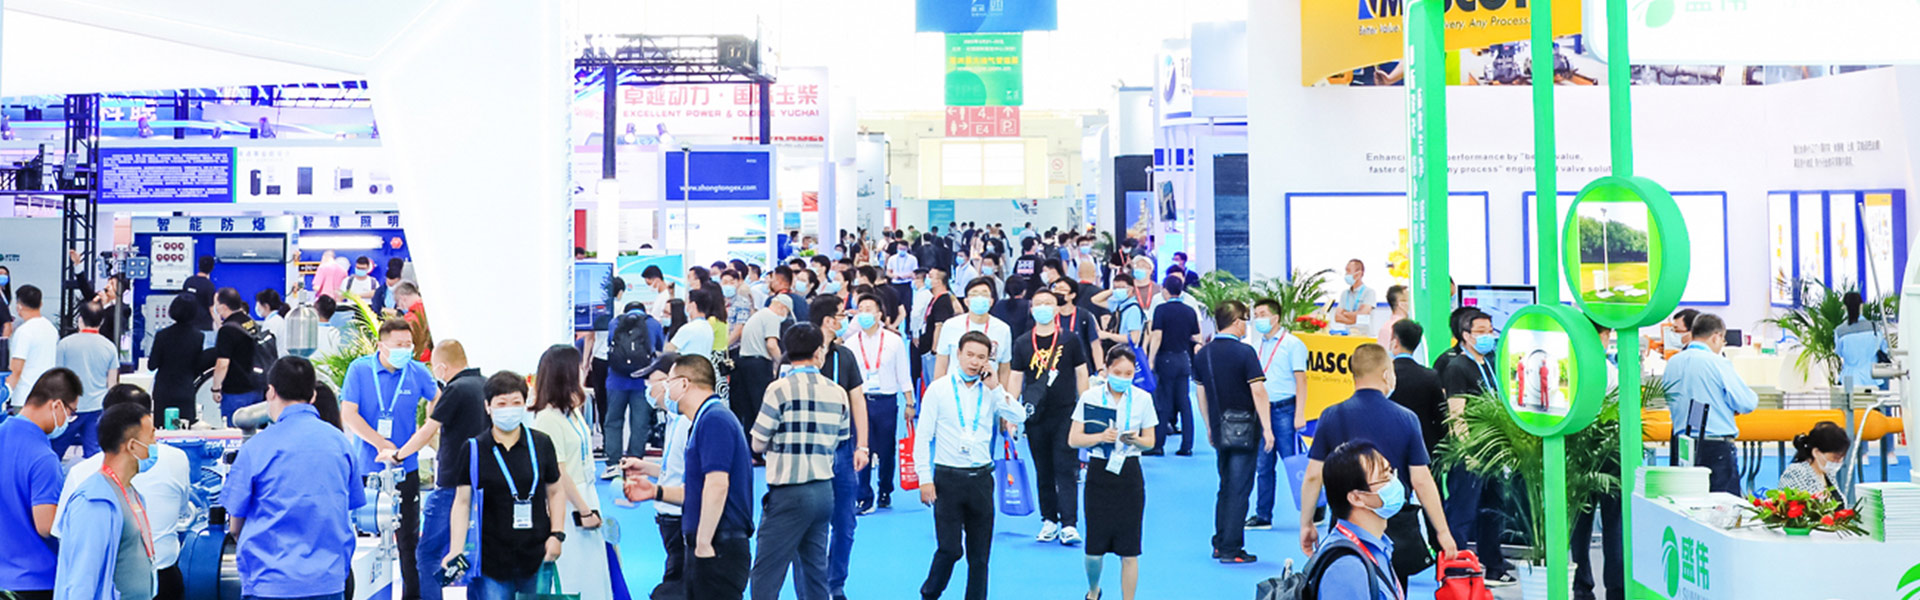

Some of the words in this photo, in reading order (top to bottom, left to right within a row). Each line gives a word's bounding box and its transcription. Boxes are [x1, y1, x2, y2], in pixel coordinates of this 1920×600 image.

[1470, 18, 1487, 29] Any
[623, 110, 681, 118] EXCELLENT
[686, 110, 721, 118] POWER
[726, 110, 733, 118] &
[780, 109, 820, 118] YUCHAI
[977, 108, 986, 119] 4
[975, 124, 990, 134] E4
[1003, 120, 1013, 133] P
[1365, 153, 1405, 161] Enhanci
[1507, 154, 1518, 162] by
[1368, 165, 1397, 173] faster
[1560, 164, 1586, 172] valve
[156, 217, 266, 232] 智能防爆
[302, 214, 400, 228] 智慧照明
[1681, 536, 1710, 591] 盛伟
